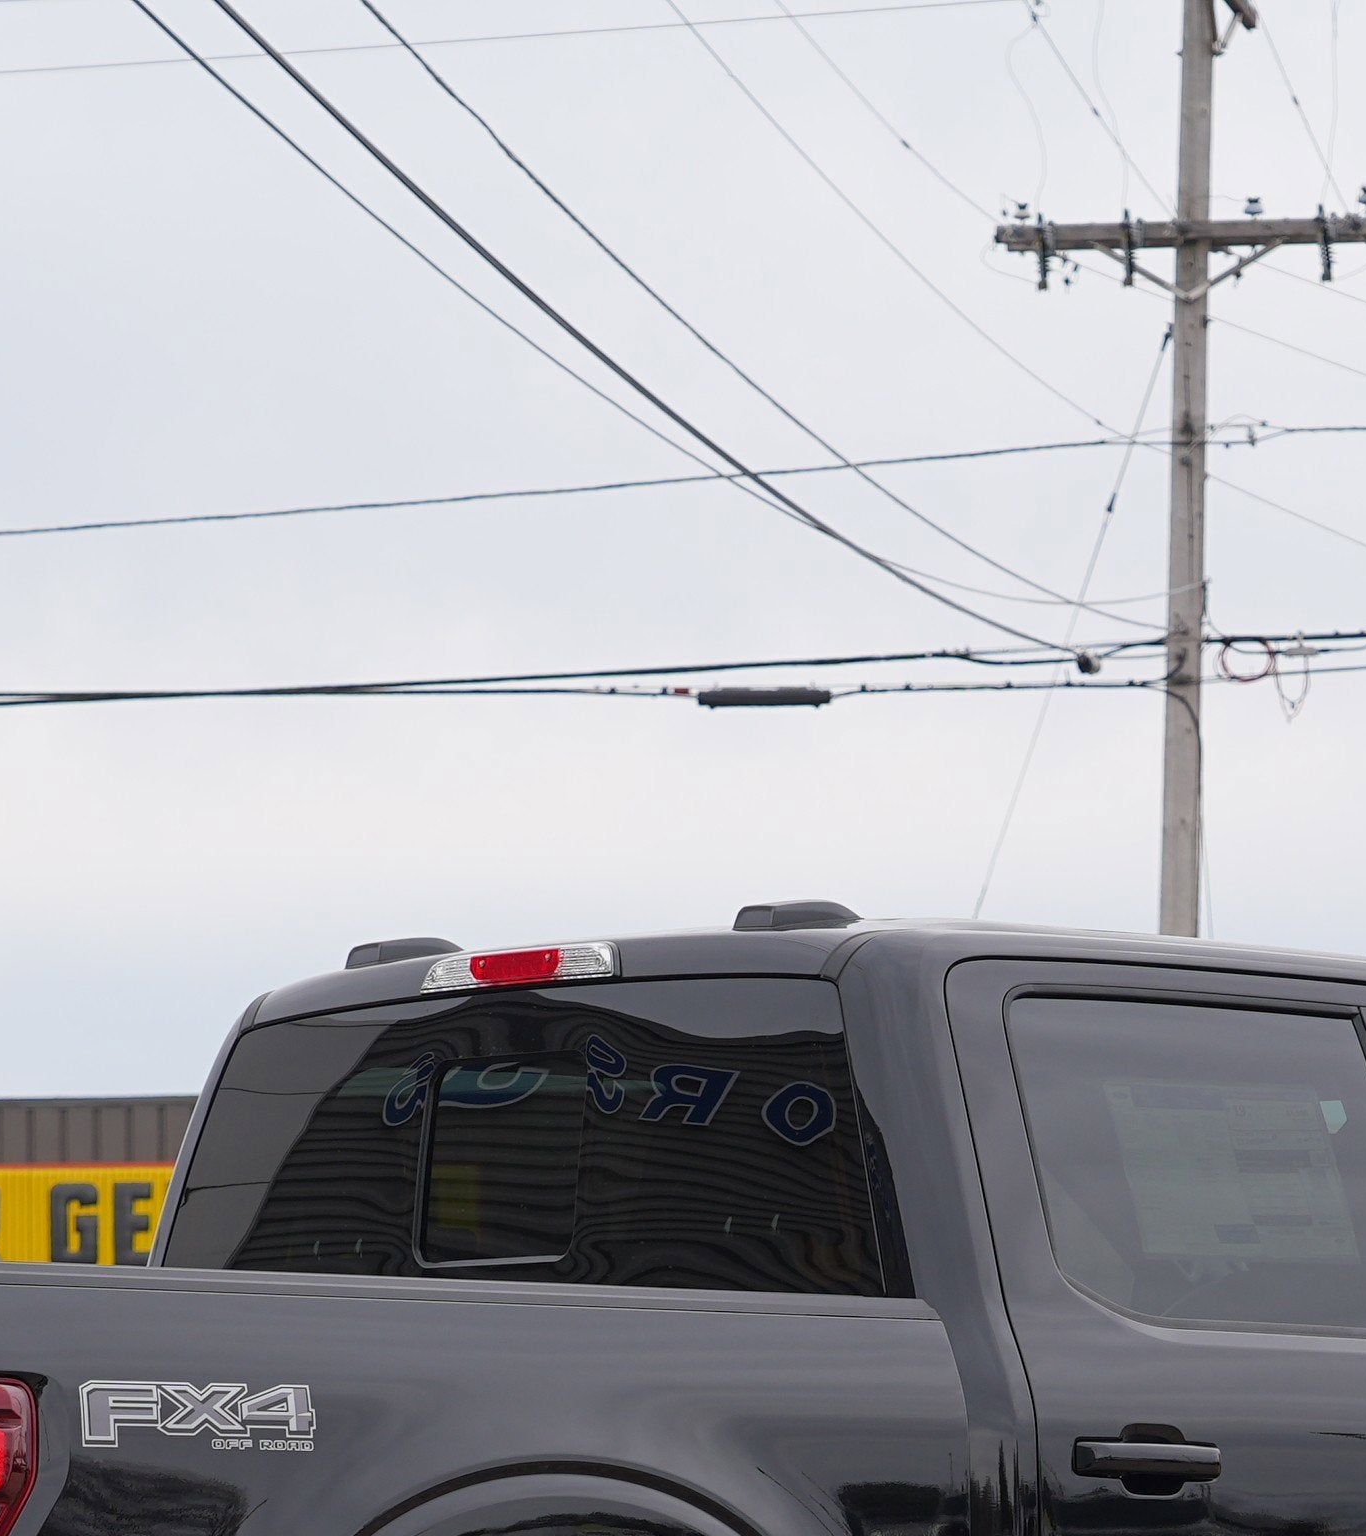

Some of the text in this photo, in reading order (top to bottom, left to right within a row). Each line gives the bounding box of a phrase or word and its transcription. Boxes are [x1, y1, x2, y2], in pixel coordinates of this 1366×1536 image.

[78, 1380, 317, 1448] FX4
[212, 1438, 315, 1452] OFF ROAD
